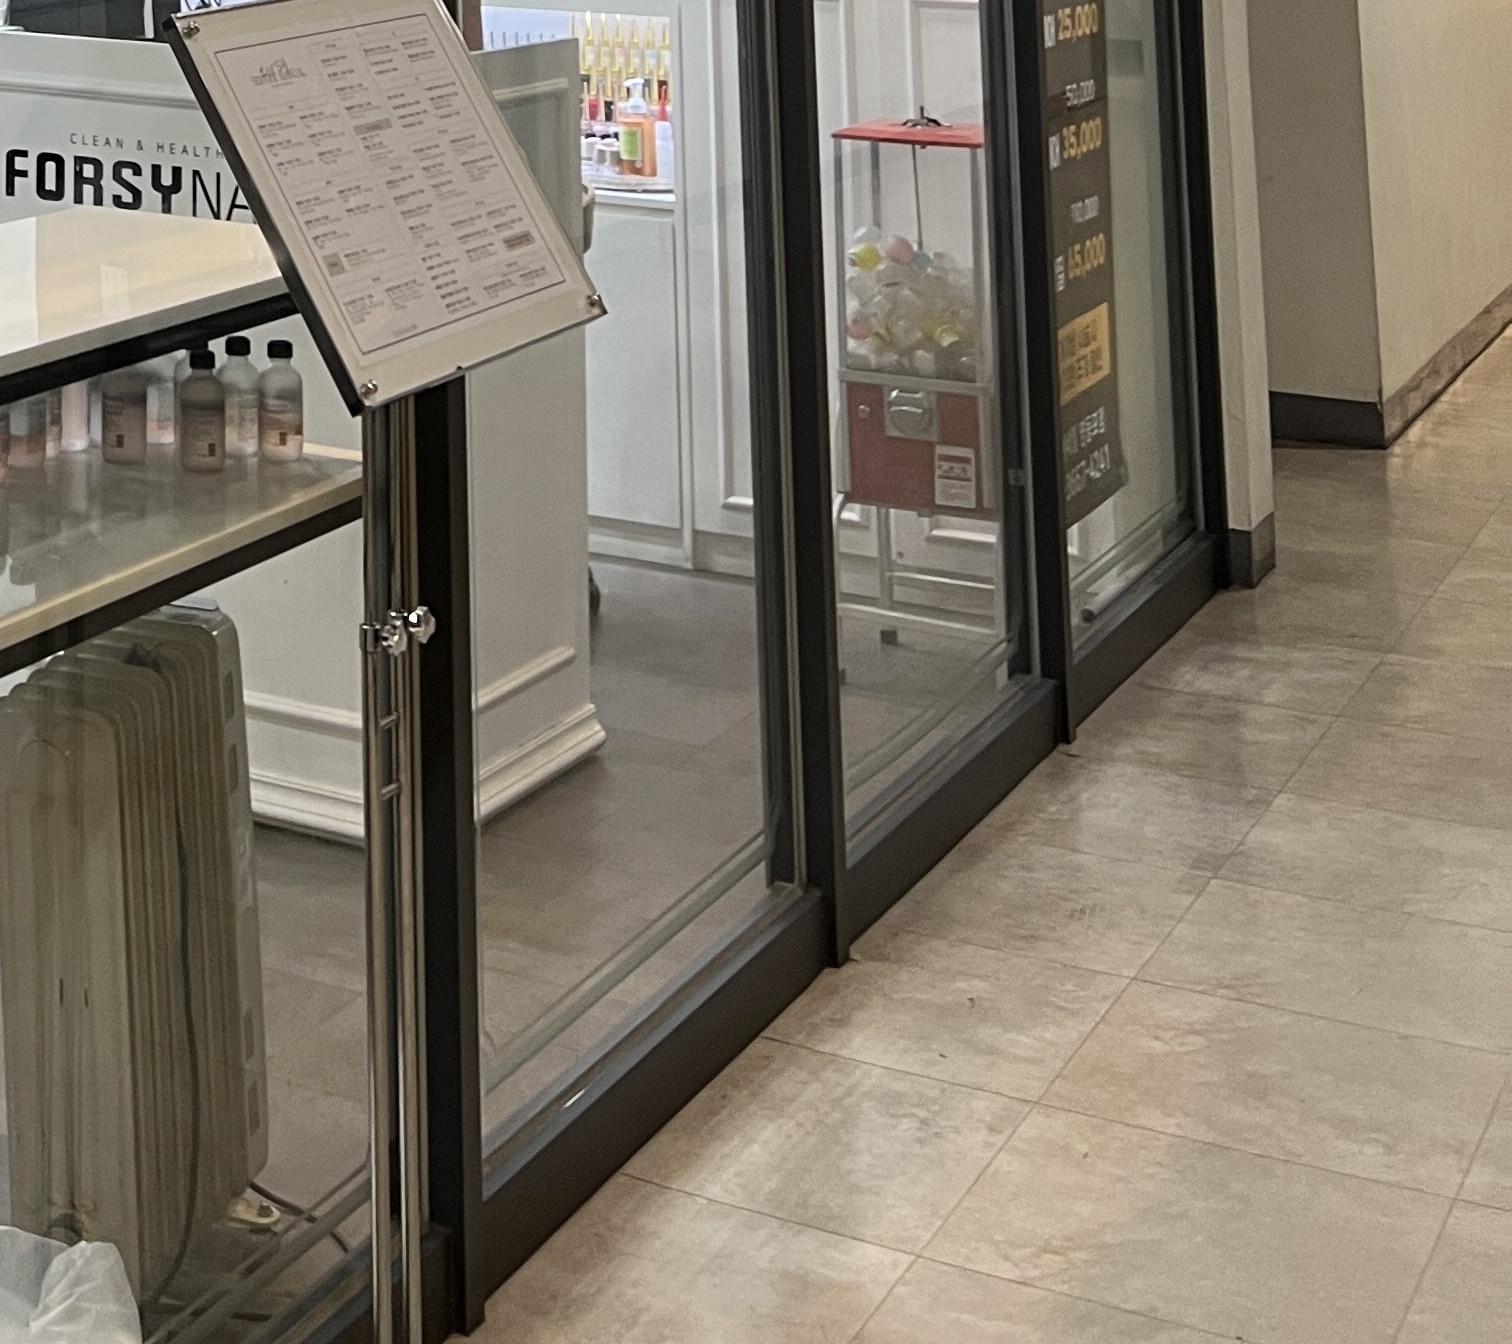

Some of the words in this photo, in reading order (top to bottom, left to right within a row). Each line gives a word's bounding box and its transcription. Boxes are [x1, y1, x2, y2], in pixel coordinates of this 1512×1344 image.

[1057, 2, 1099, 42] 25,000
[69, 132, 125, 150] CLEAN
[136, 139, 145, 152] &
[156, 141, 224, 159] HEALTH
[5, 147, 254, 224] FORSYNA
